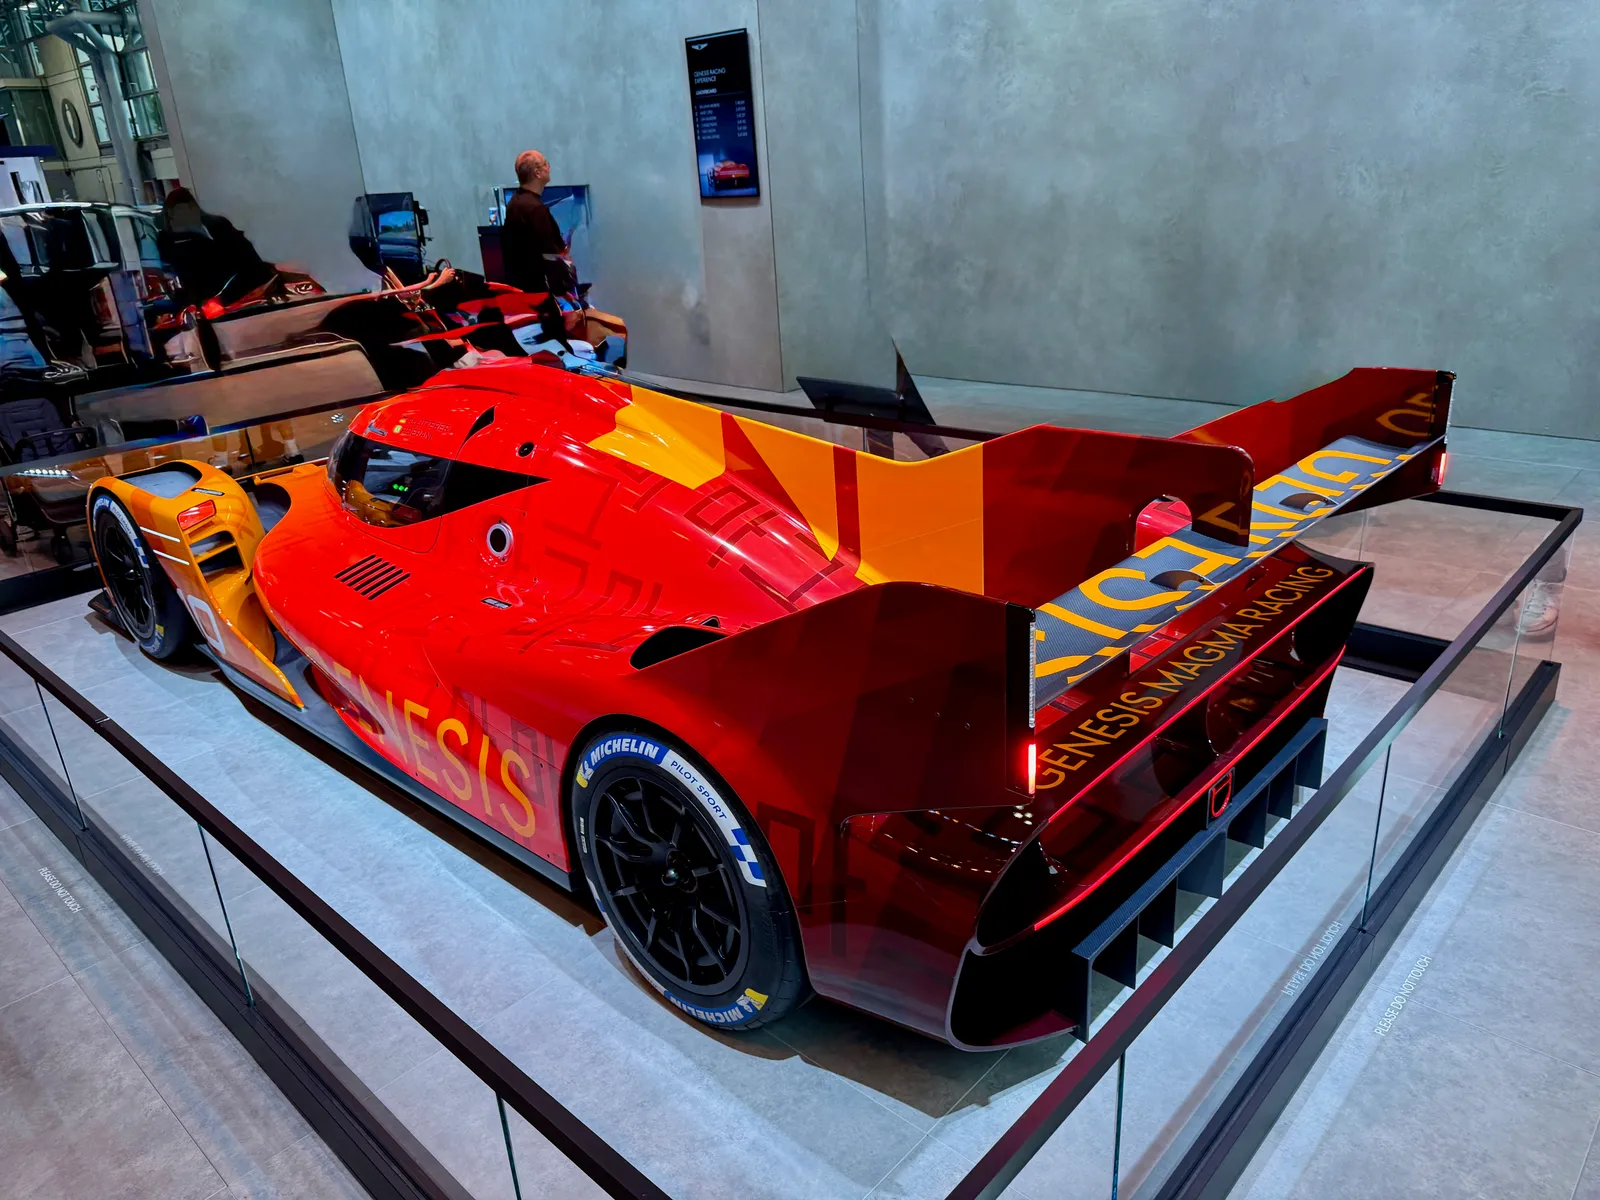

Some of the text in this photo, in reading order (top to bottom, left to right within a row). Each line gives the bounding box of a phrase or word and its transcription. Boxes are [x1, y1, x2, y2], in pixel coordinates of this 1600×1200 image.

[1035, 566, 1334, 789] GENESIS MAGMA RACING
[590, 738, 659, 764] MICHELIN
[670, 760, 727, 819] PILOT SPORT
[63, 895, 84, 913] TOUCH
[1373, 954, 1432, 1036] PLEASE DO NOT TOUCH
